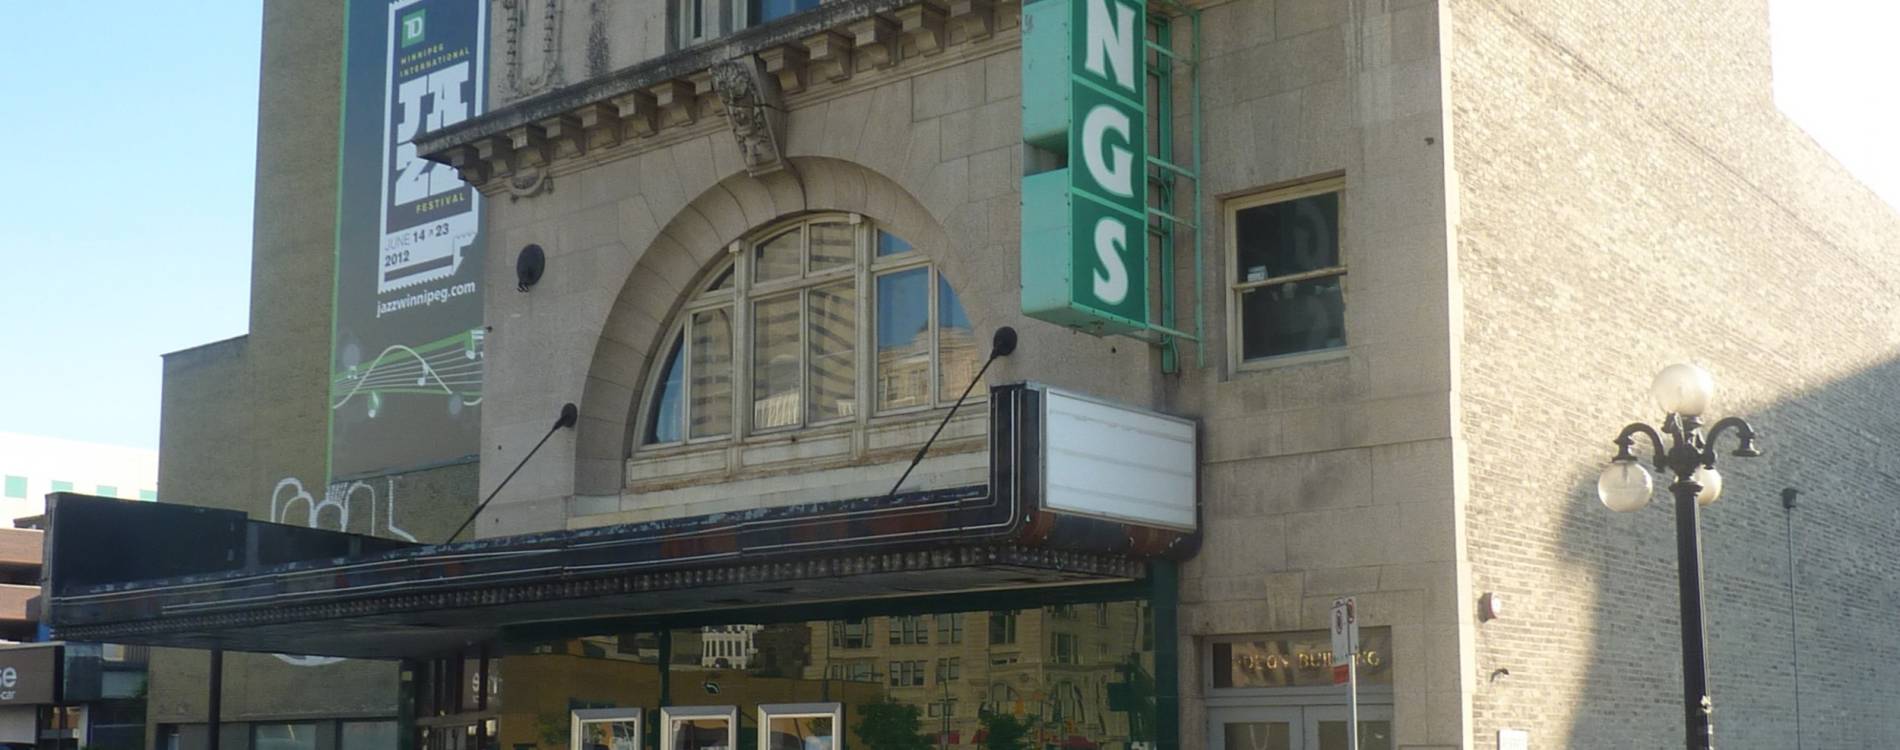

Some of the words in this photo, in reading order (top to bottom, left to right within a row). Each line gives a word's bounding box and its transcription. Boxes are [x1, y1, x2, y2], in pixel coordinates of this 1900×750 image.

[404, 16, 423, 40] TD
[400, 47, 469, 78] INTERNATIONAL
[401, 43, 444, 65] WINNIPEG
[416, 193, 465, 214] FESTIVAL
[385, 233, 411, 251] JUNE
[413, 229, 425, 243] 14
[435, 223, 450, 237] 23
[384, 250, 410, 268] 2012
[376, 281, 476, 318] jazzwinnipeg.com
[1297, 650, 1380, 668] BUILNG
